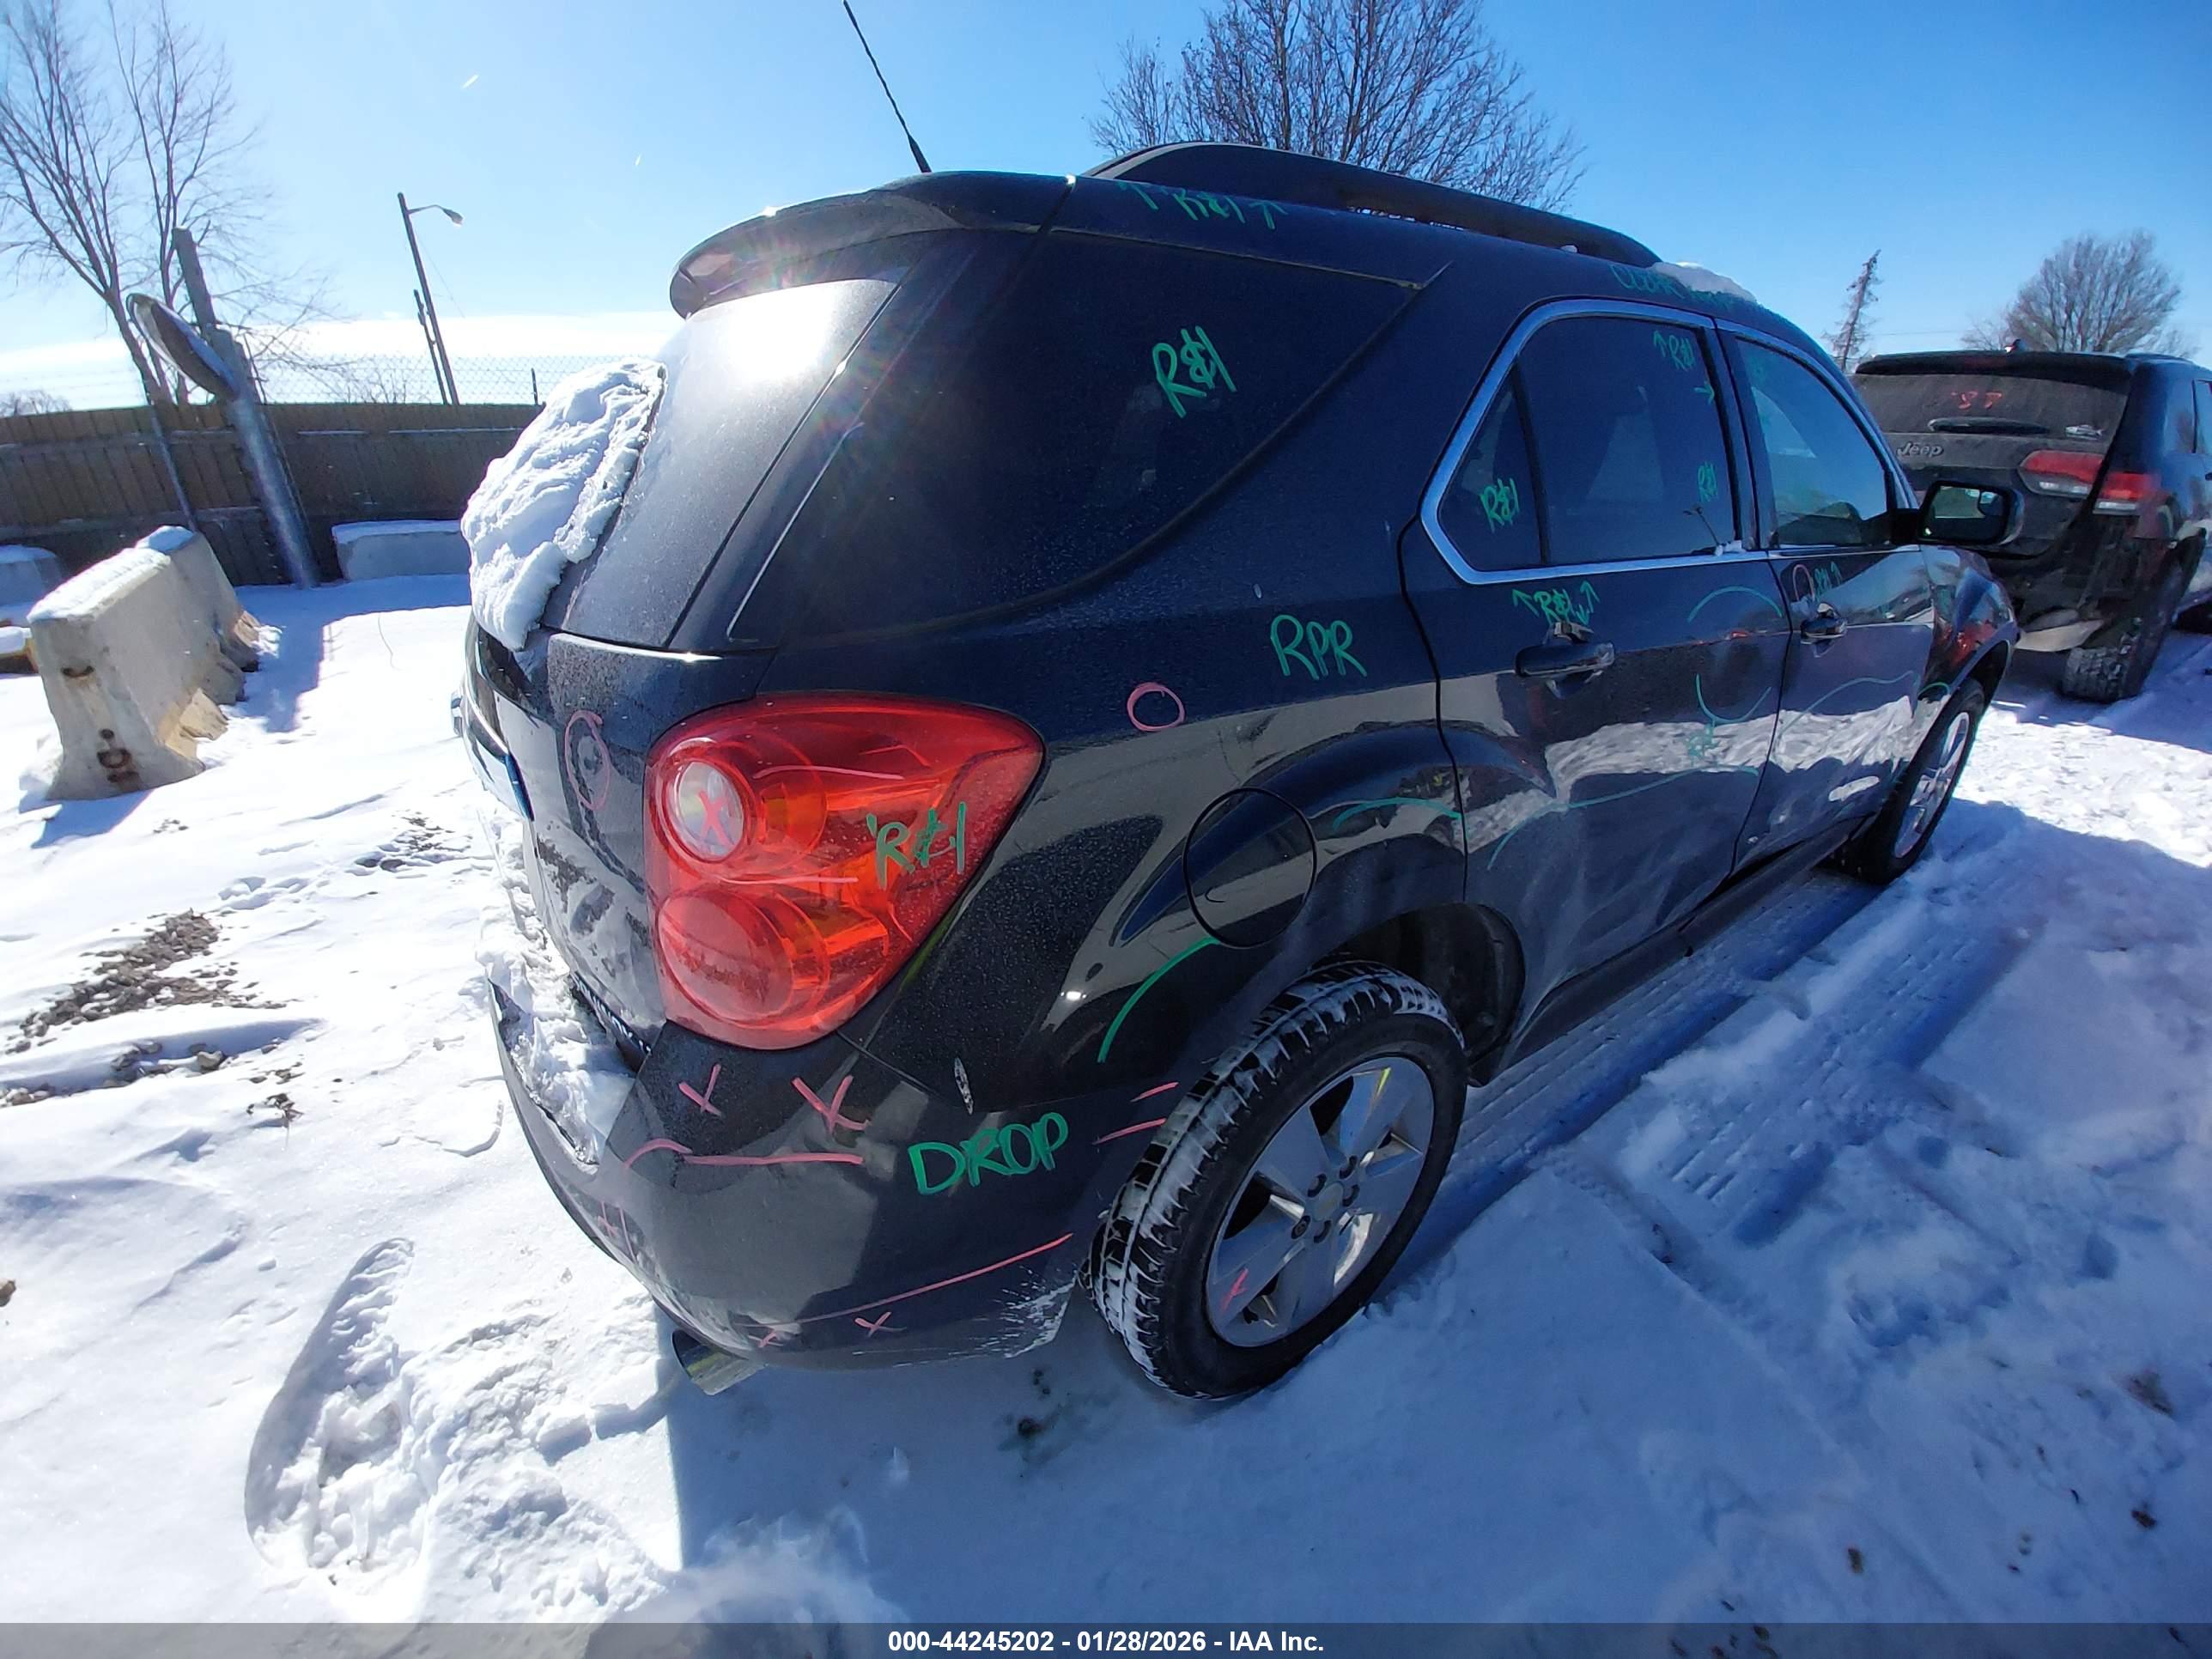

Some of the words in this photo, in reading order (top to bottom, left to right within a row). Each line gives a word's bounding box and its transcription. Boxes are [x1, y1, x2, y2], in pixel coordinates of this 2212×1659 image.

[1895, 441, 1945, 459] Jeep
[1270, 614, 1367, 680] RPR
[907, 1111, 1069, 1194] DROP
